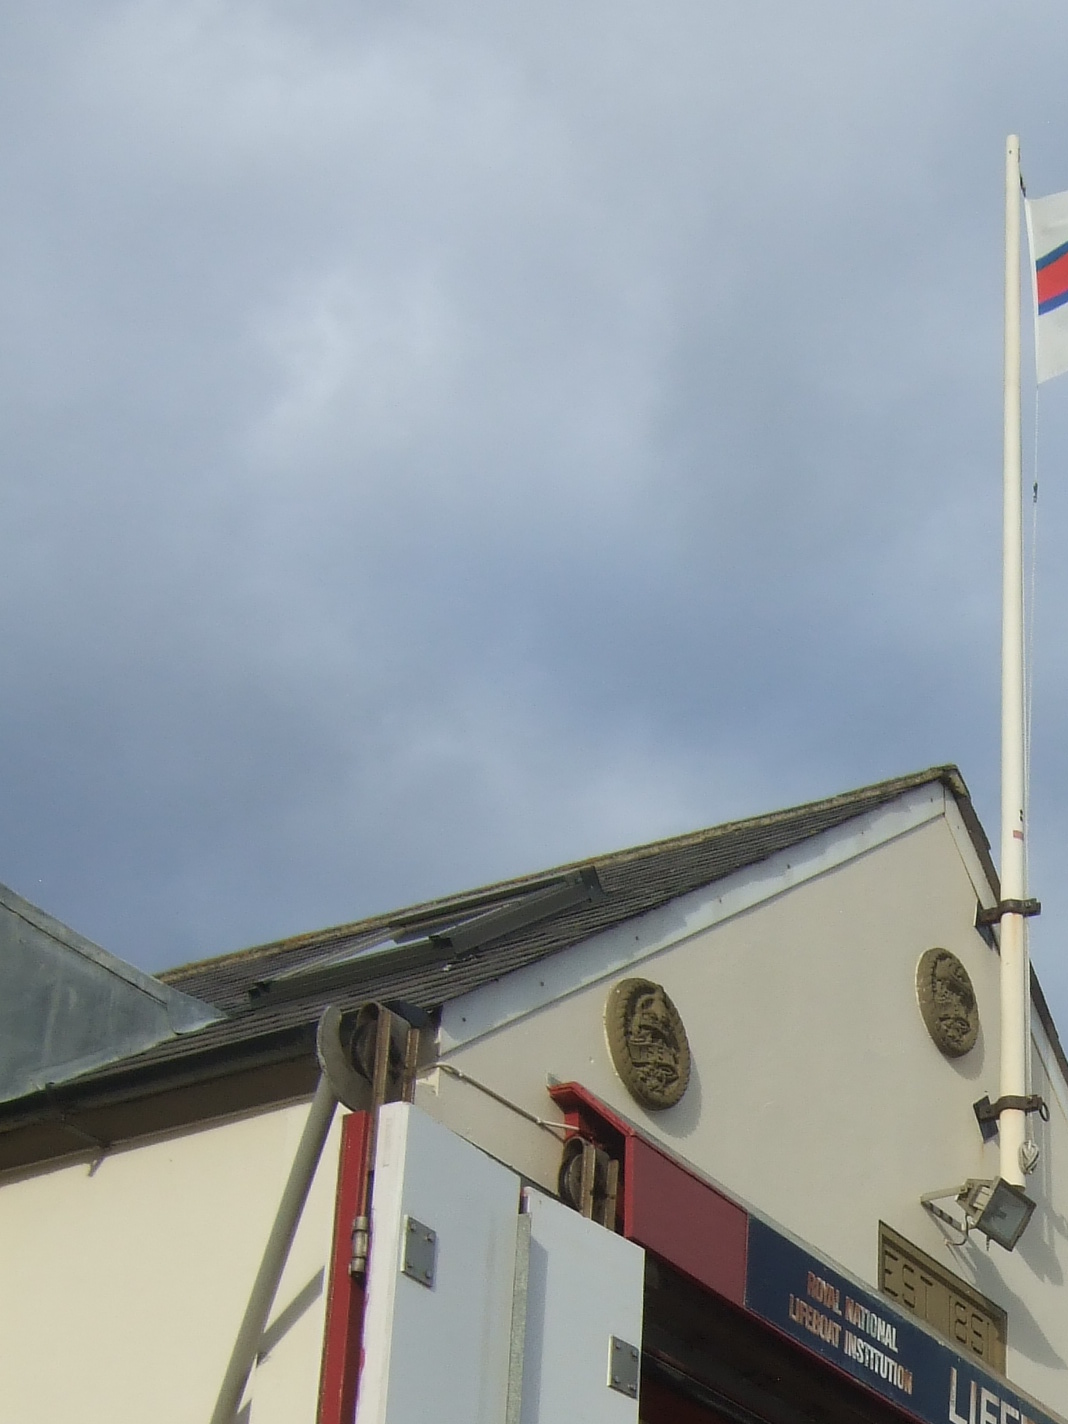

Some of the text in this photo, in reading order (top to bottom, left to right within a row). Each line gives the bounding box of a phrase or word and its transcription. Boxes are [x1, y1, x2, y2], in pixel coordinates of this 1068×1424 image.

[788, 1293, 913, 1395] LIFEBOAT INSTITUTION
[807, 1270, 899, 1353] ROYAL NATIONAL
